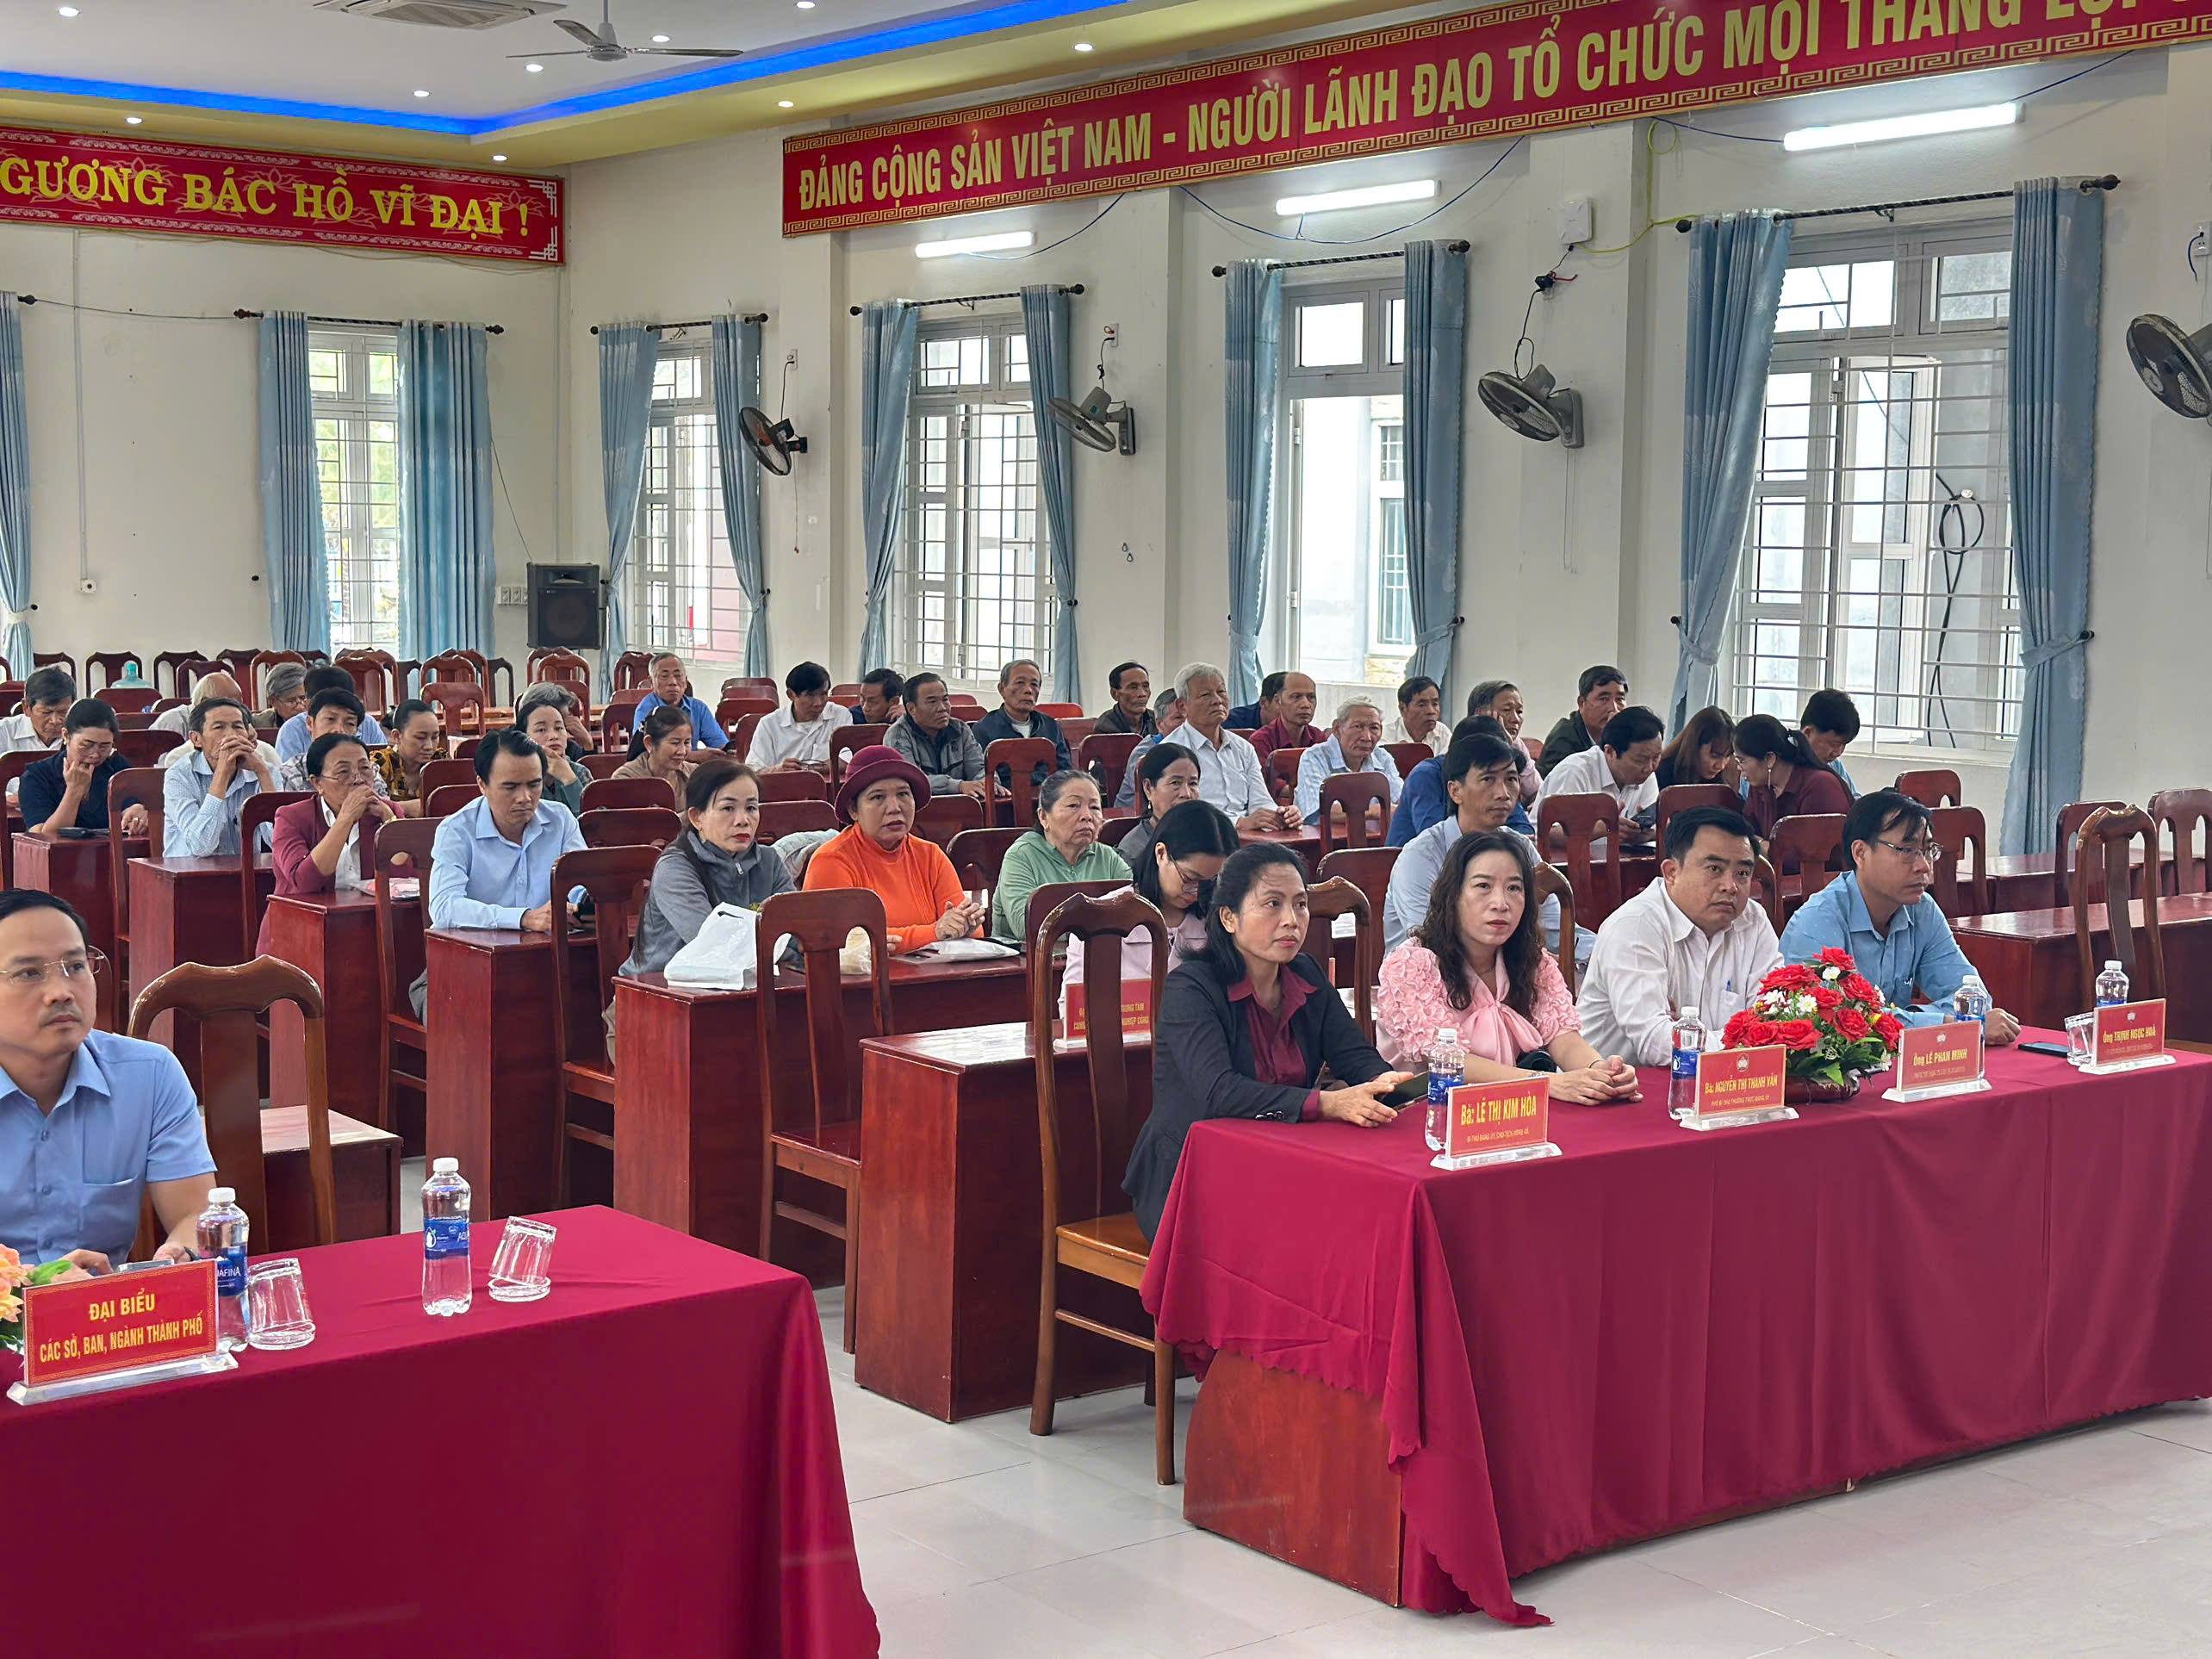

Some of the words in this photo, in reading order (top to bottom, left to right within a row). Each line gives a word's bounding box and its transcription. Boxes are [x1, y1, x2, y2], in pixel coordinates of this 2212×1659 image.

[798, 152, 863, 210] ĐẢNG
[872, 144, 941, 208] CỘNG
[950, 127, 1002, 189] SẢN
[1011, 122, 1074, 185] VIỆT
[1084, 112, 1152, 168] NAM
[1188, 82, 1290, 152] NGƯỜI
[1304, 66, 1398, 134] LÃNH
[1412, 52, 1493, 125] ĐẠO
[1508, 15, 1561, 101] TỔ
[1577, 4, 1704, 91] CHỨC
[1723, 0, 1819, 75] MỌI
[0, 156, 166, 205] GƯƠNG
[183, 166, 276, 214] BÁC
[293, 166, 353, 221] HỒ
[370, 183, 415, 226] VĨ
[429, 195, 504, 239] ĐẠI
[1714, 1075, 1737, 1093] NGUYỄN
[1748, 1076, 1766, 1089] THANH
[1460, 1103, 1475, 1126] Bà:
[1476, 1097, 1486, 1123] LÊ
[1488, 1098, 1501, 1125] THỊ
[1503, 1097, 1519, 1120] KIM
[1520, 1090, 1537, 1117] HÒA
[89, 1299, 115, 1322] ĐẠI
[121, 1288, 155, 1315] BIỂU
[40, 1336, 61, 1364] CÁC
[64, 1333, 81, 1360] SỞ,
[83, 1336, 108, 1356] BAN,
[110, 1325, 144, 1350] NGÀNH
[146, 1319, 179, 1344] THÀNH
[182, 1309, 203, 1337] PHỐ
